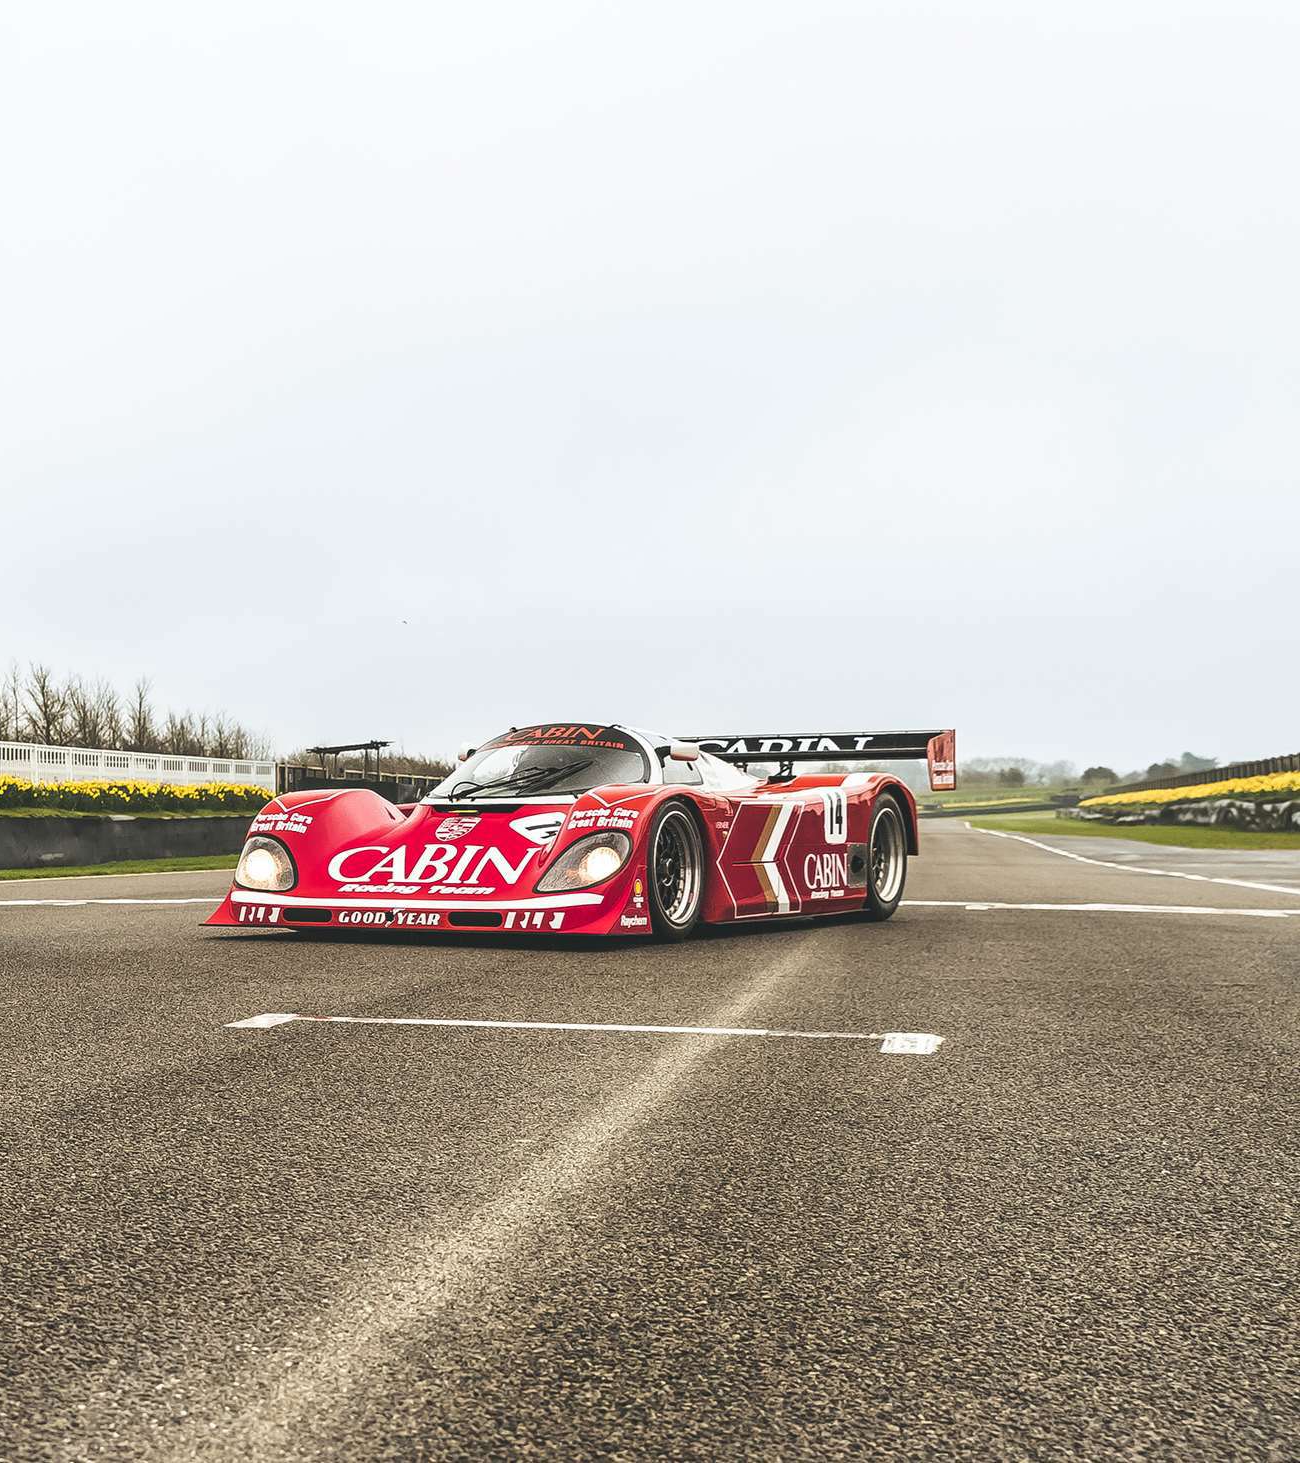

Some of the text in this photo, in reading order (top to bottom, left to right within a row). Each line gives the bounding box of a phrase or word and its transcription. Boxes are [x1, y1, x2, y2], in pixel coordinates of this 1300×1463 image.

[505, 726, 604, 741] CABIN
[290, 812, 314, 824] Cars
[572, 807, 640, 820] Porsche Cars
[827, 791, 843, 835] 14
[275, 821, 307, 834] Britain
[596, 818, 634, 829] Britain
[328, 844, 543, 885] CABIN
[804, 853, 848, 890] CABIN
[337, 883, 496, 895] Racing Team
